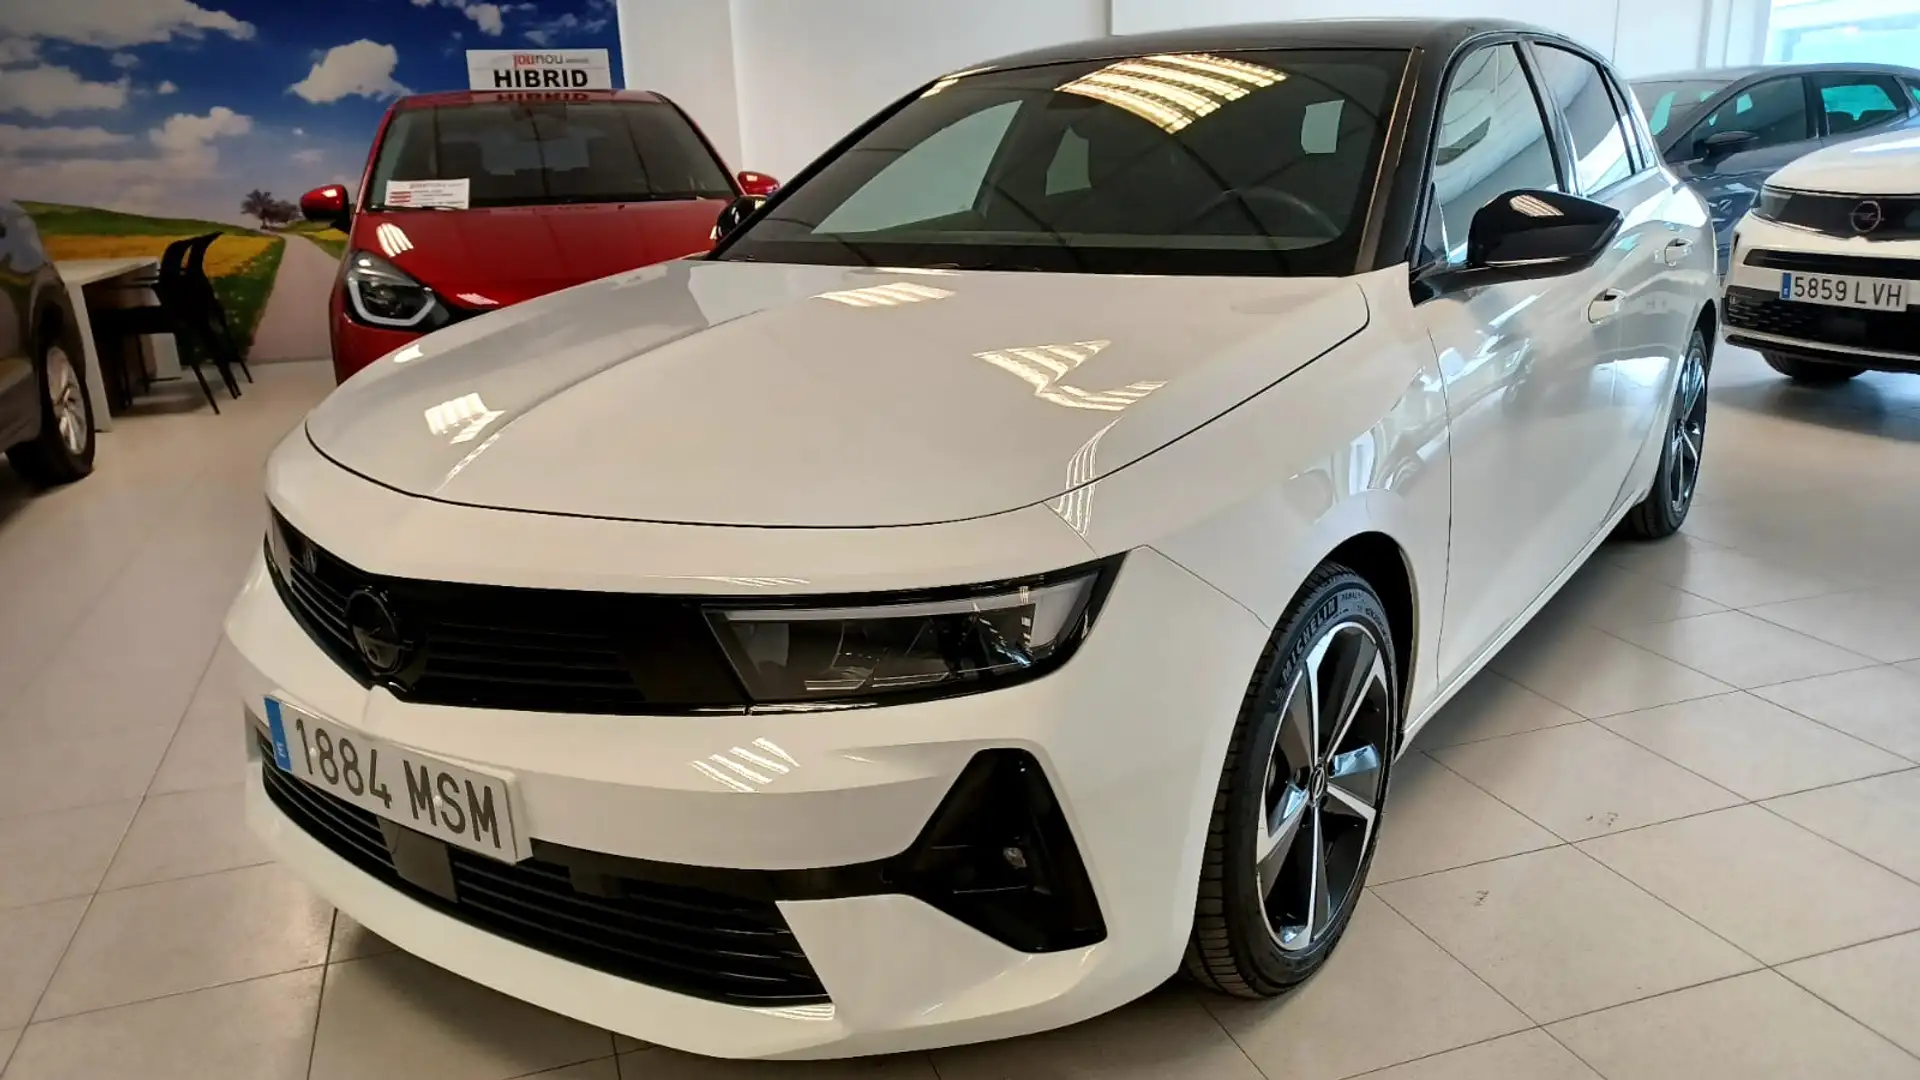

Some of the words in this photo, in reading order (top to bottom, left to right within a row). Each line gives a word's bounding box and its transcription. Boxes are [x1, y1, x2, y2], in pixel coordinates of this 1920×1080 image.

[513, 54, 563, 67] jounou
[494, 69, 588, 88] HIBRID
[1794, 276, 1847, 302] 5859
[1854, 280, 1902, 307] LVH
[1281, 598, 1337, 682] MICHELIN
[295, 717, 393, 809] 1884
[403, 759, 502, 849] MSM
